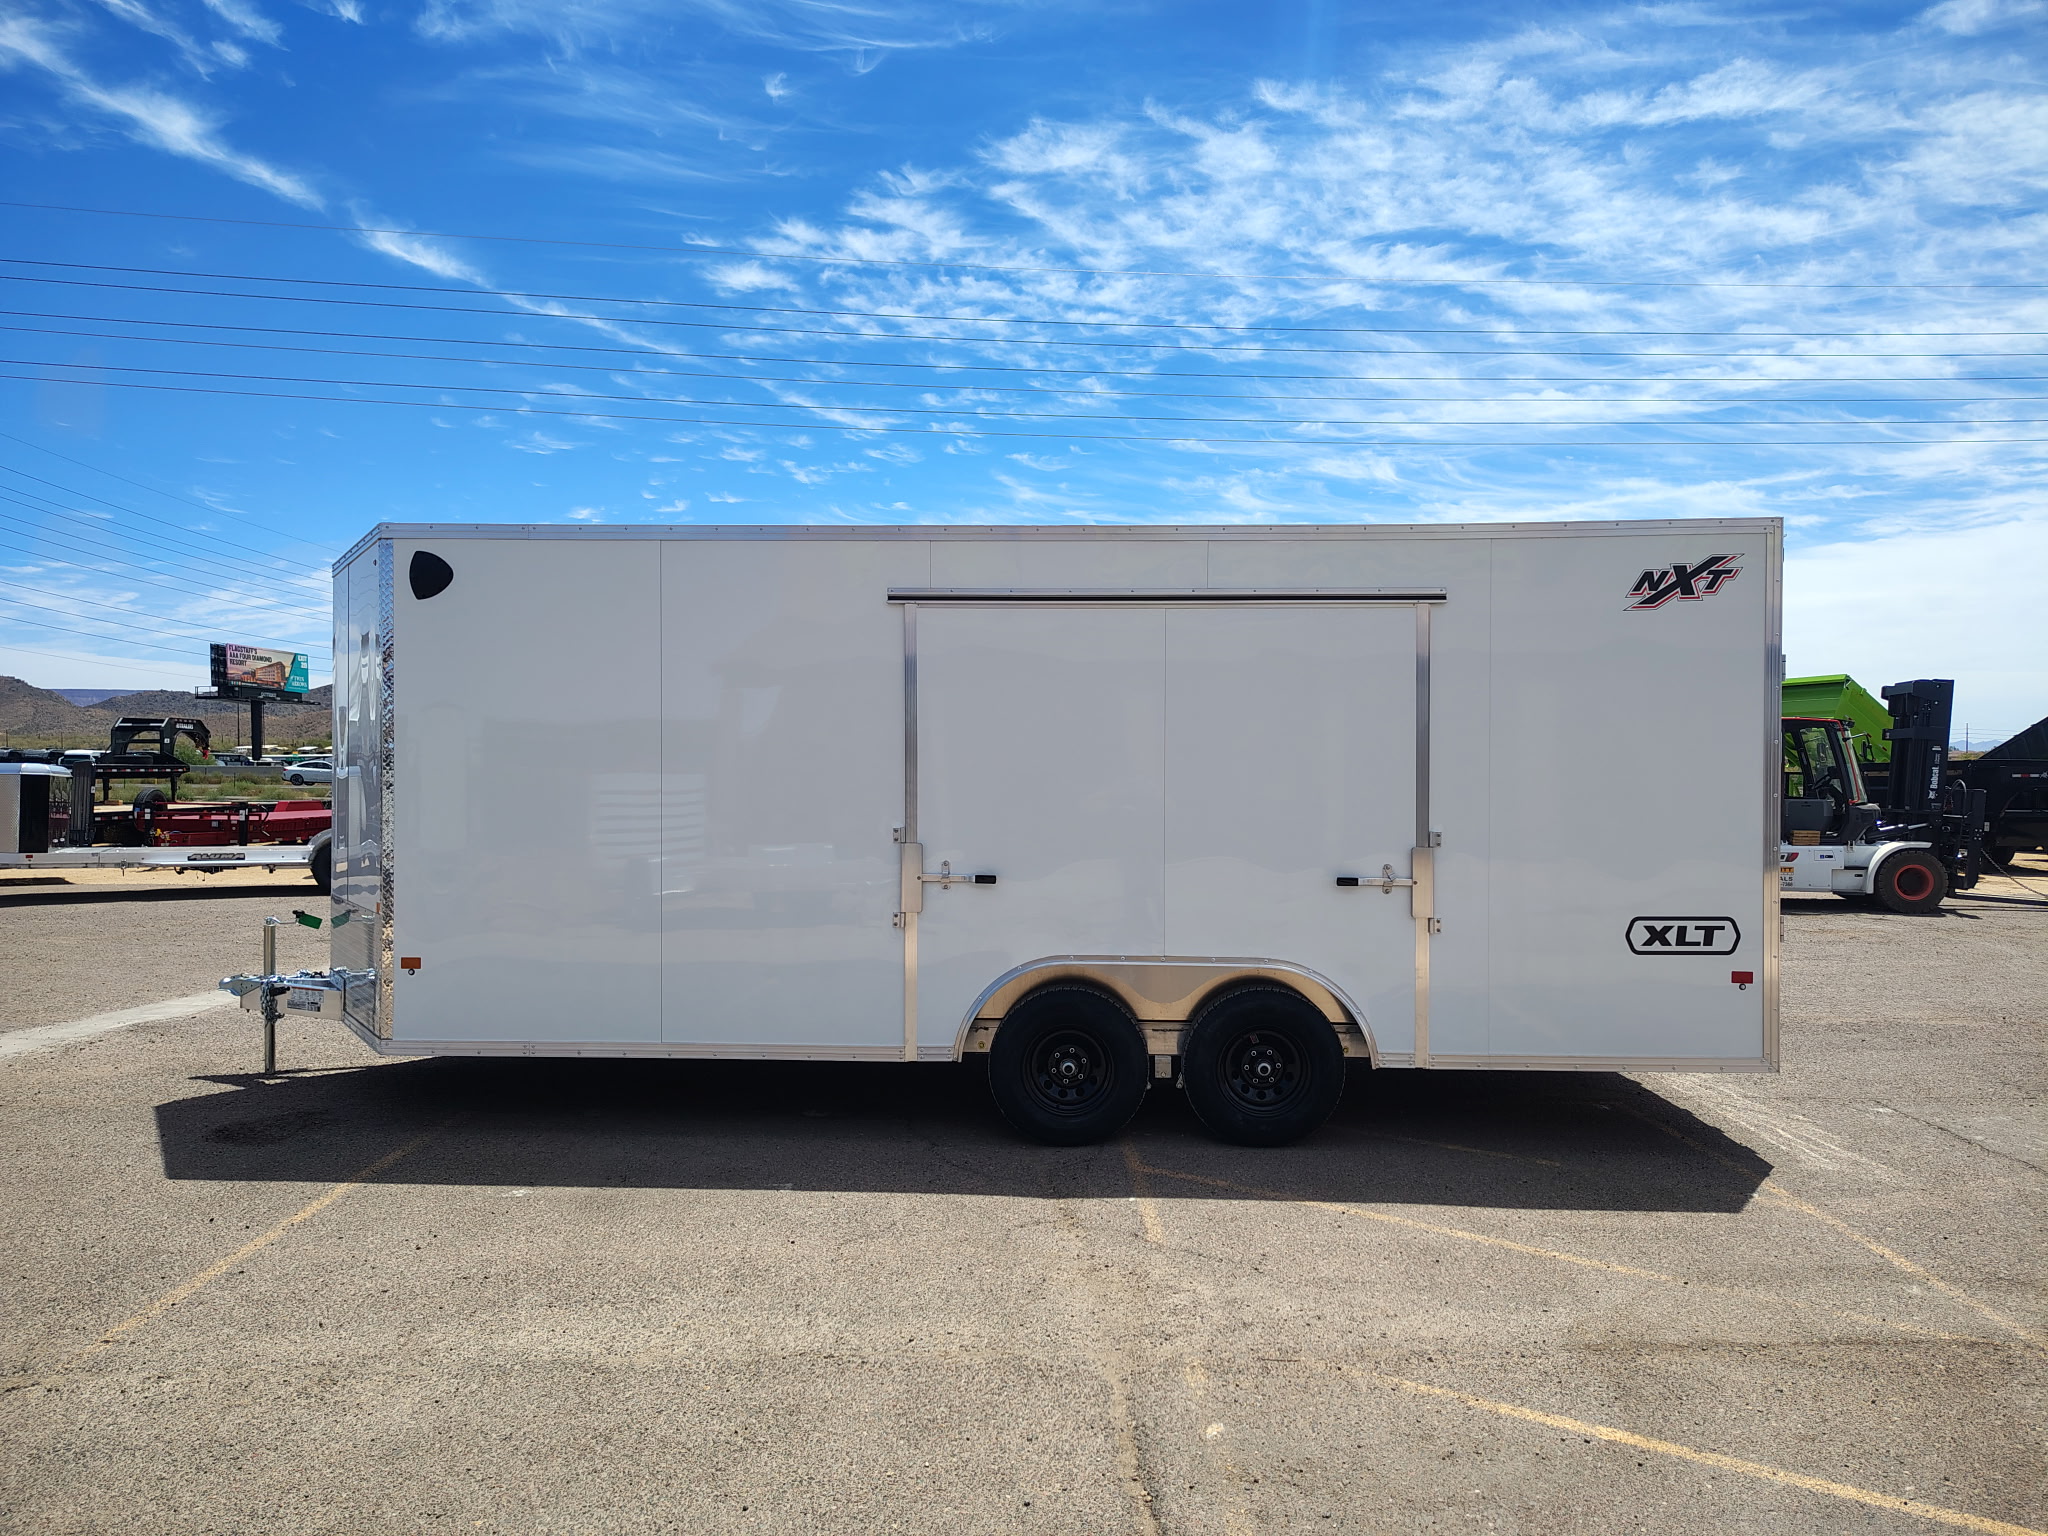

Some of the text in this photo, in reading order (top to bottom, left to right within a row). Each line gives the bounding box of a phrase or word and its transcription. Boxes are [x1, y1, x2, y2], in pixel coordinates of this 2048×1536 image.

[1625, 554, 1743, 610] NXT
[229, 651, 239, 659] AAA
[252, 654, 273, 663] DIAMOND
[229, 658, 247, 666] RESORT
[1930, 766, 1940, 789] Bobcat
[1640, 925, 1725, 946] XLT
